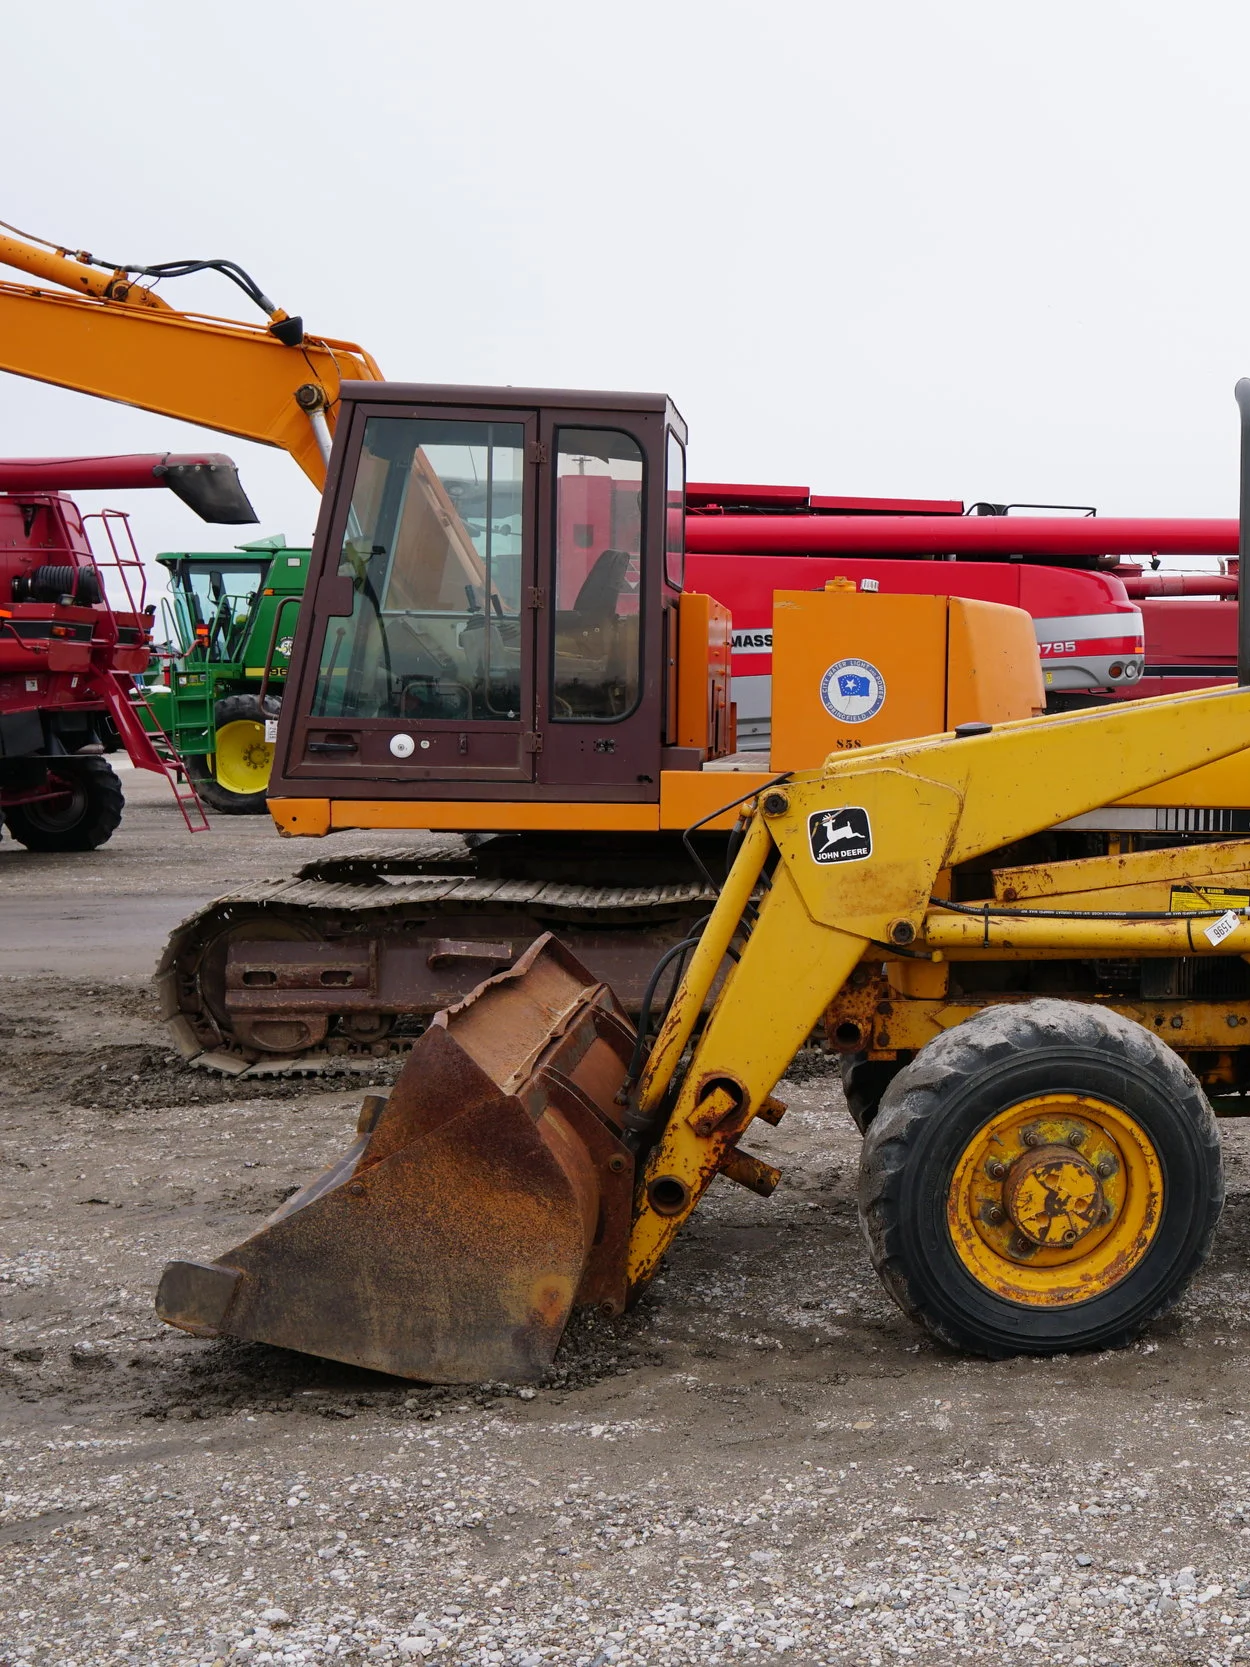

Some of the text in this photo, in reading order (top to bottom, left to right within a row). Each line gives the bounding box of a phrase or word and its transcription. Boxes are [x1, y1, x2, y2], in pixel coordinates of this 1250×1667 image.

[828, 661, 847, 677] WATER
[850, 660, 869, 669] LIGHT
[876, 676, 885, 700] POWER
[836, 739, 862, 749] 858
[817, 847, 868, 861] JOHN DEERE
[1213, 919, 1232, 939] 1596
